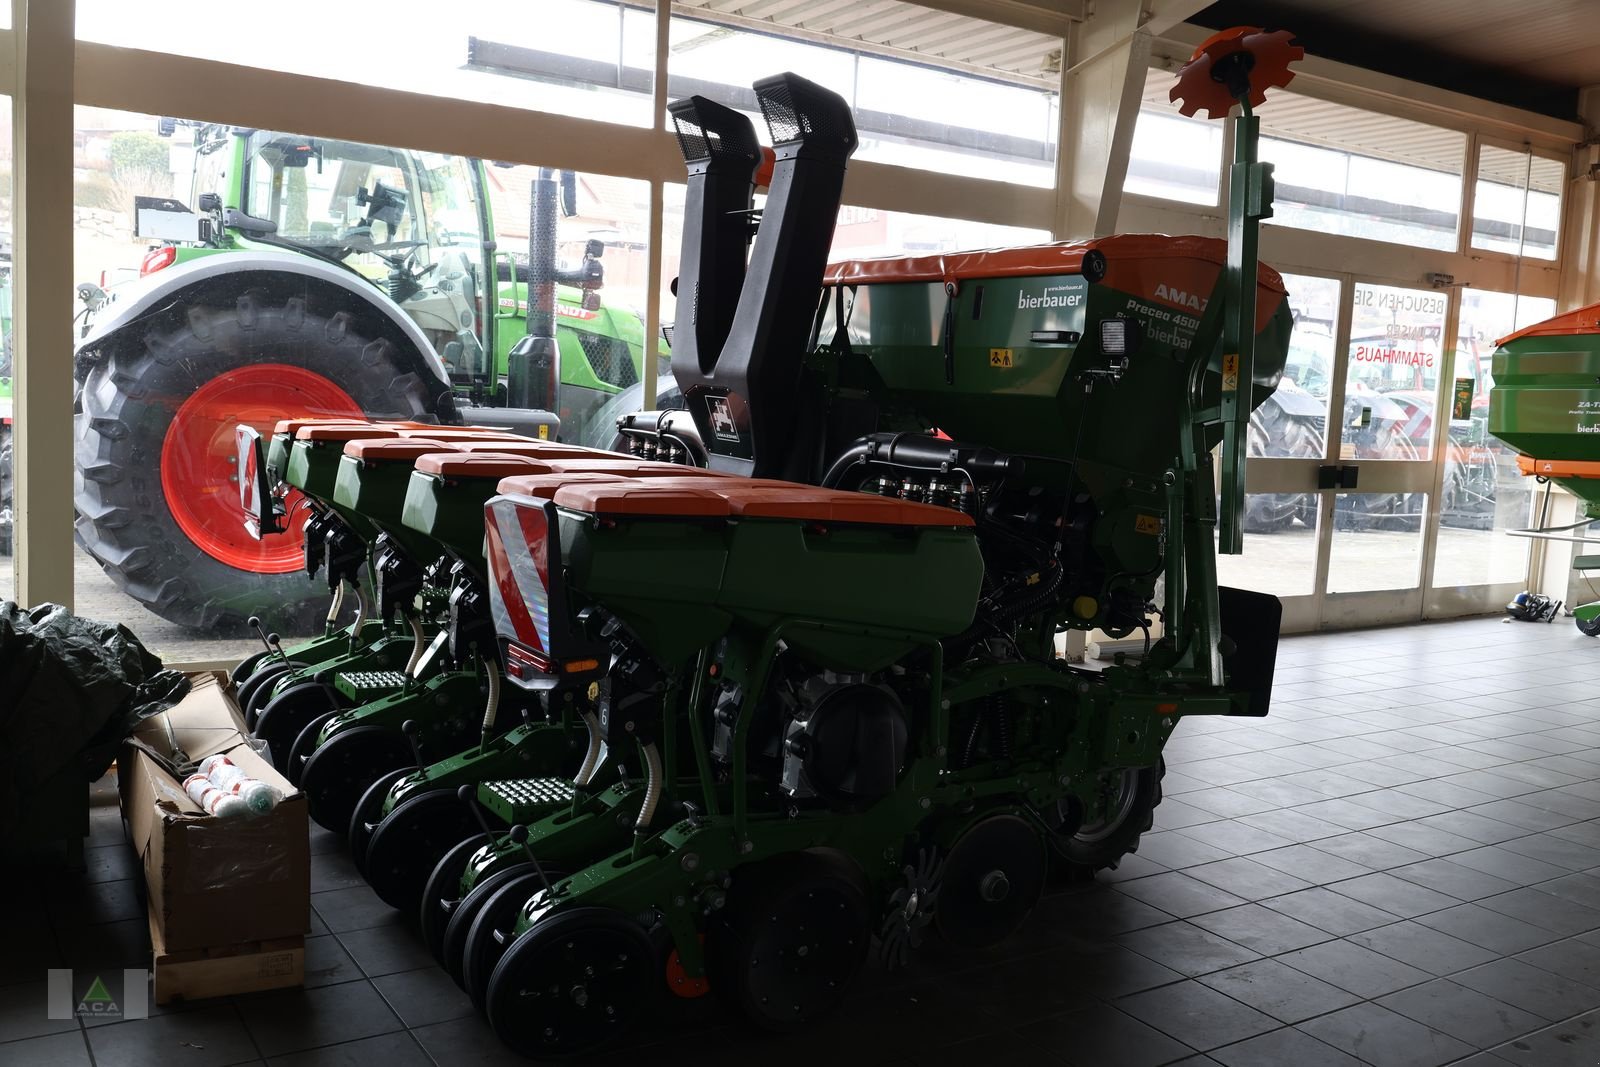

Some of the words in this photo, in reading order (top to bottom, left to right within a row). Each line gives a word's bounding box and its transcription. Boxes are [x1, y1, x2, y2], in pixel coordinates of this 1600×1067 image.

[1018, 287, 1082, 310] bierbauer
[558, 303, 590, 319] NDT
[1126, 298, 1170, 322] Precea
[1577, 423, 1600, 433] bierb
[602, 708, 607, 726] 6
